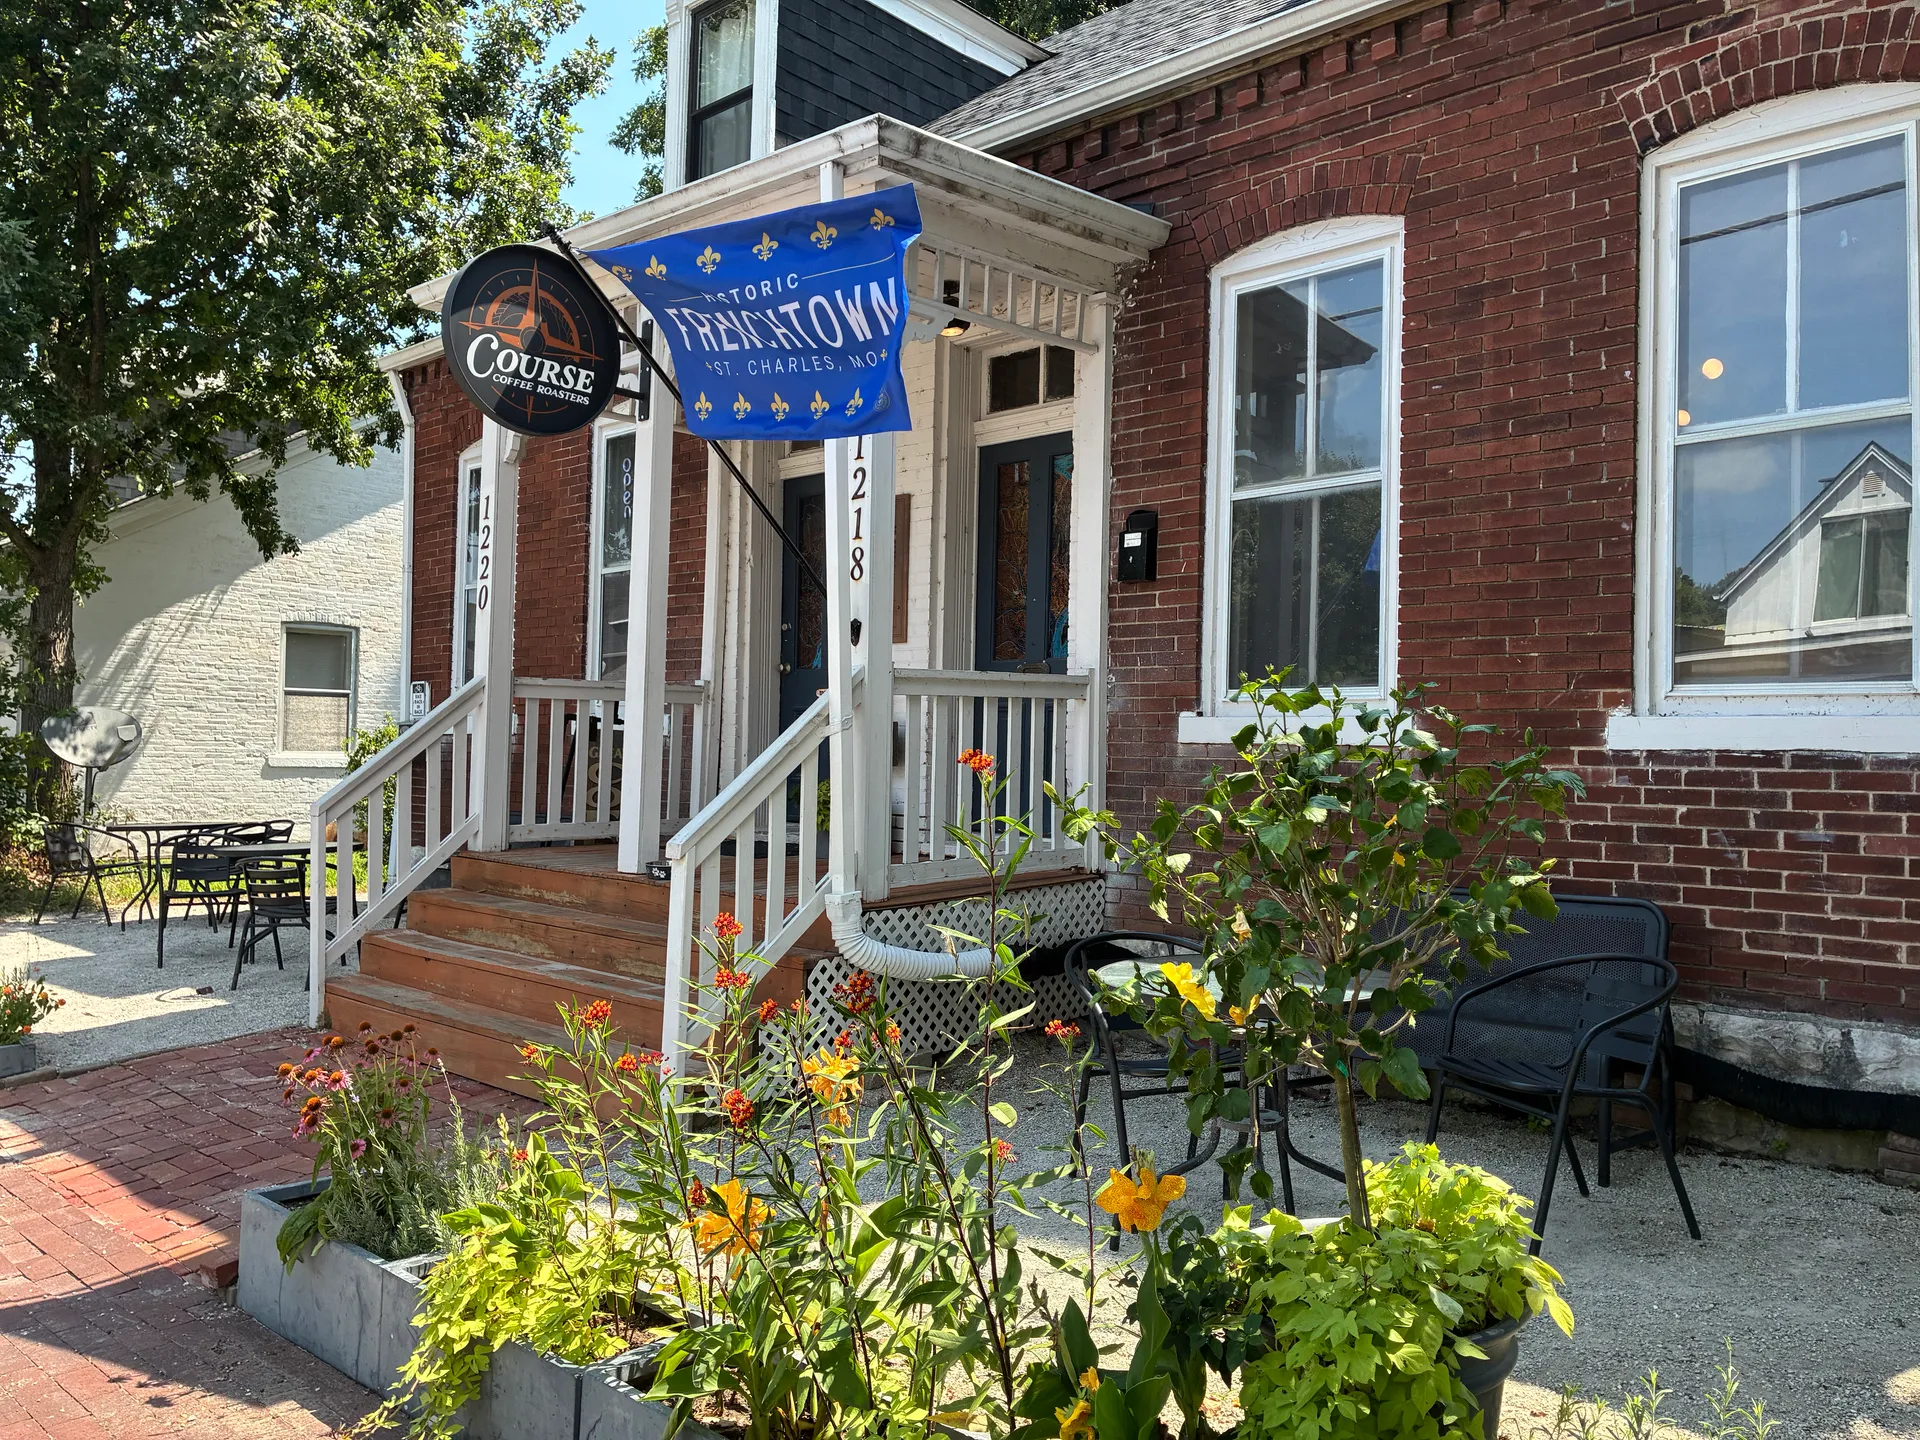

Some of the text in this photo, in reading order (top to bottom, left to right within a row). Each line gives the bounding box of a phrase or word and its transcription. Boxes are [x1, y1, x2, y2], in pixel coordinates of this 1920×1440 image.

[664, 276, 899, 352] FRENCHTOWN
[466, 333, 595, 394] COURSE
[492, 373, 590, 405] COFFEE ROASTERS
[713, 351, 878, 376] ST. CHARLES, MO
[850, 435, 867, 582] 1218
[478, 495, 491, 610] 1220
